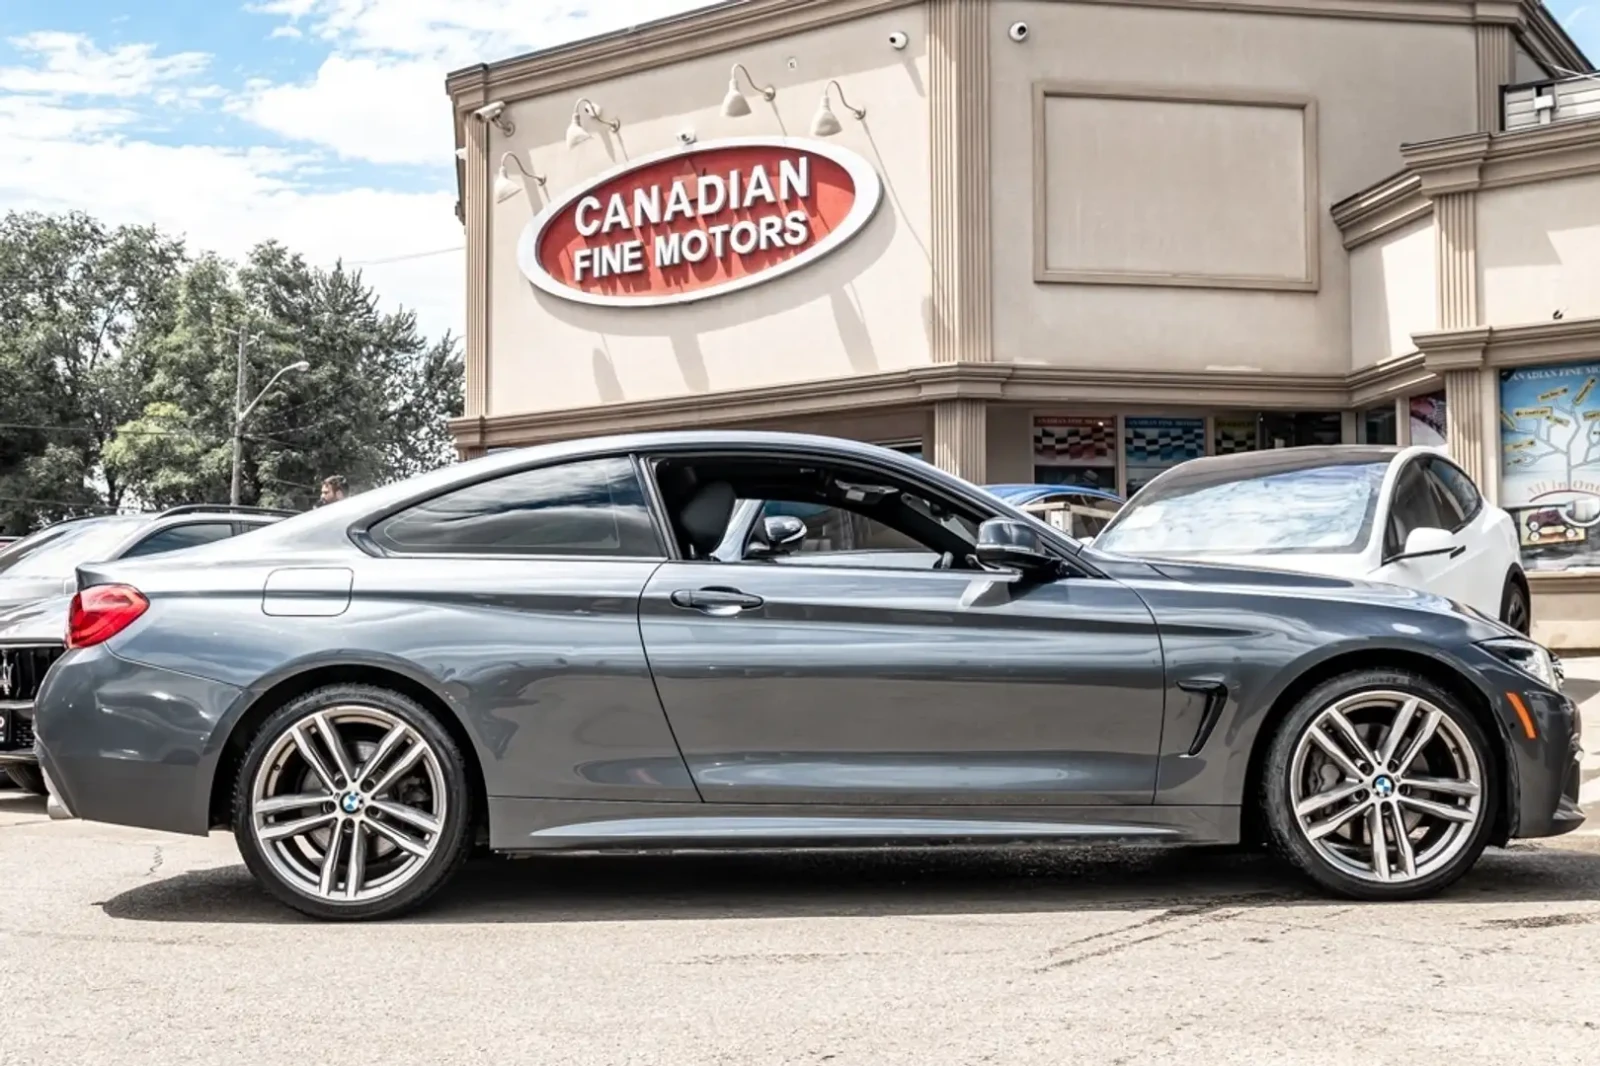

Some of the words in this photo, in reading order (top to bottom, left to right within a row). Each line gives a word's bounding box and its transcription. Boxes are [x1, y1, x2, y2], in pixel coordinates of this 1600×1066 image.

[575, 157, 809, 237] CANADIAN
[574, 240, 643, 281] FINE
[655, 210, 808, 267] MOTORS
[1511, 369, 1558, 380] ANADIAN
